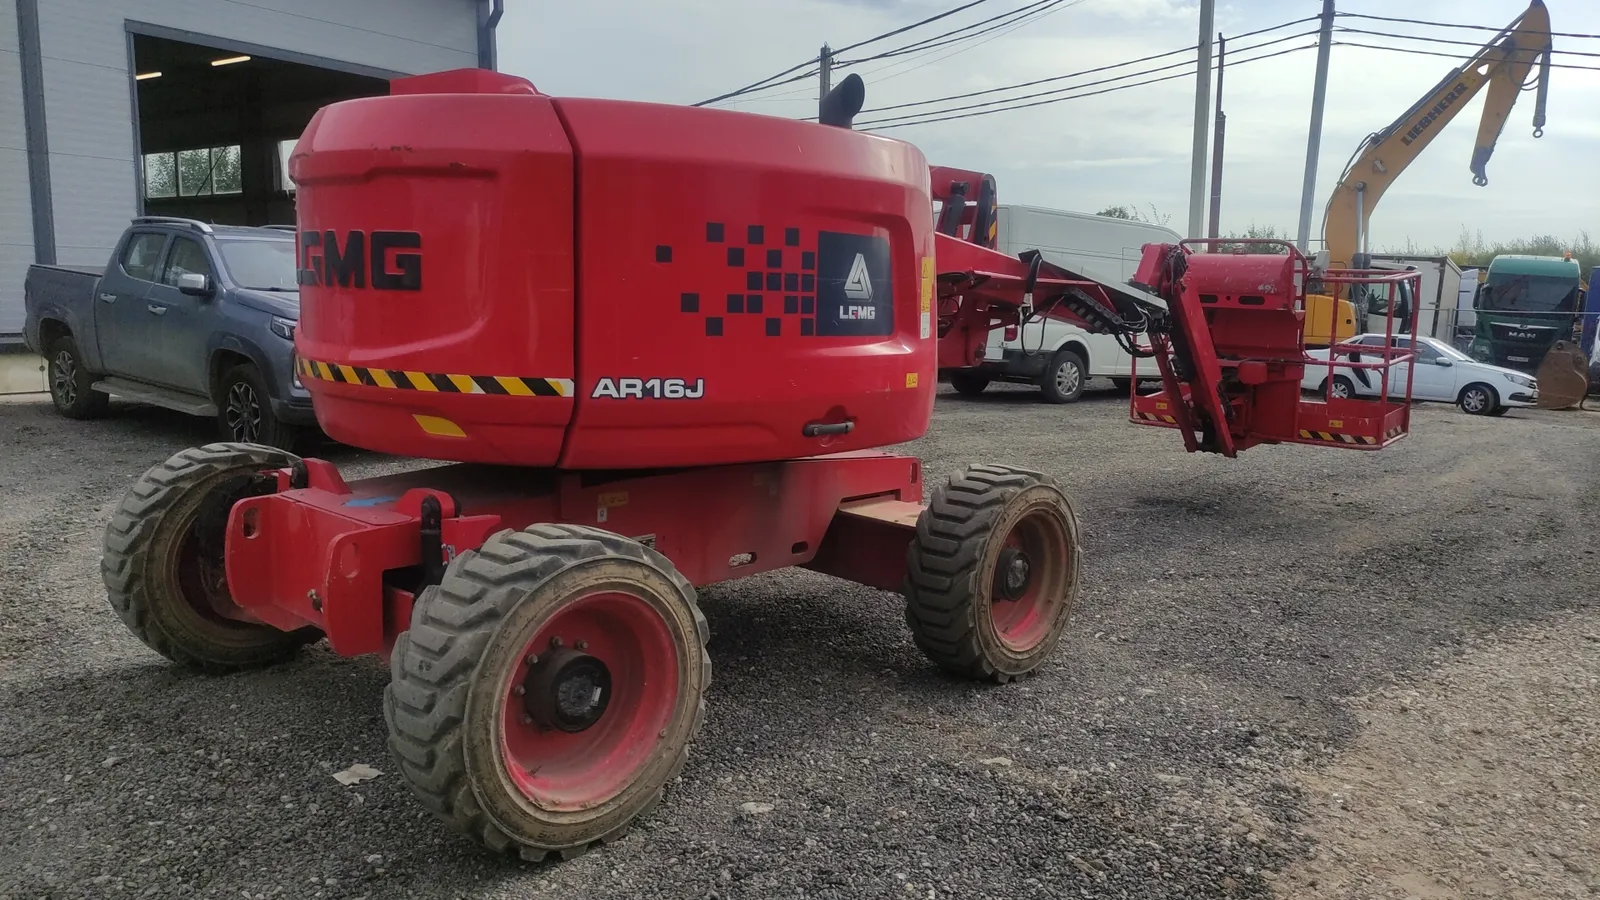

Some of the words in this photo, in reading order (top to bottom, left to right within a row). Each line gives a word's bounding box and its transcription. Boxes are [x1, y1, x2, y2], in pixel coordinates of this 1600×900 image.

[1401, 82, 1468, 146] LIEBHERR
[297, 230, 422, 290] GMG
[839, 305, 876, 320] LGMG
[1508, 331, 1536, 339] MAN
[591, 377, 704, 399] AR16J
